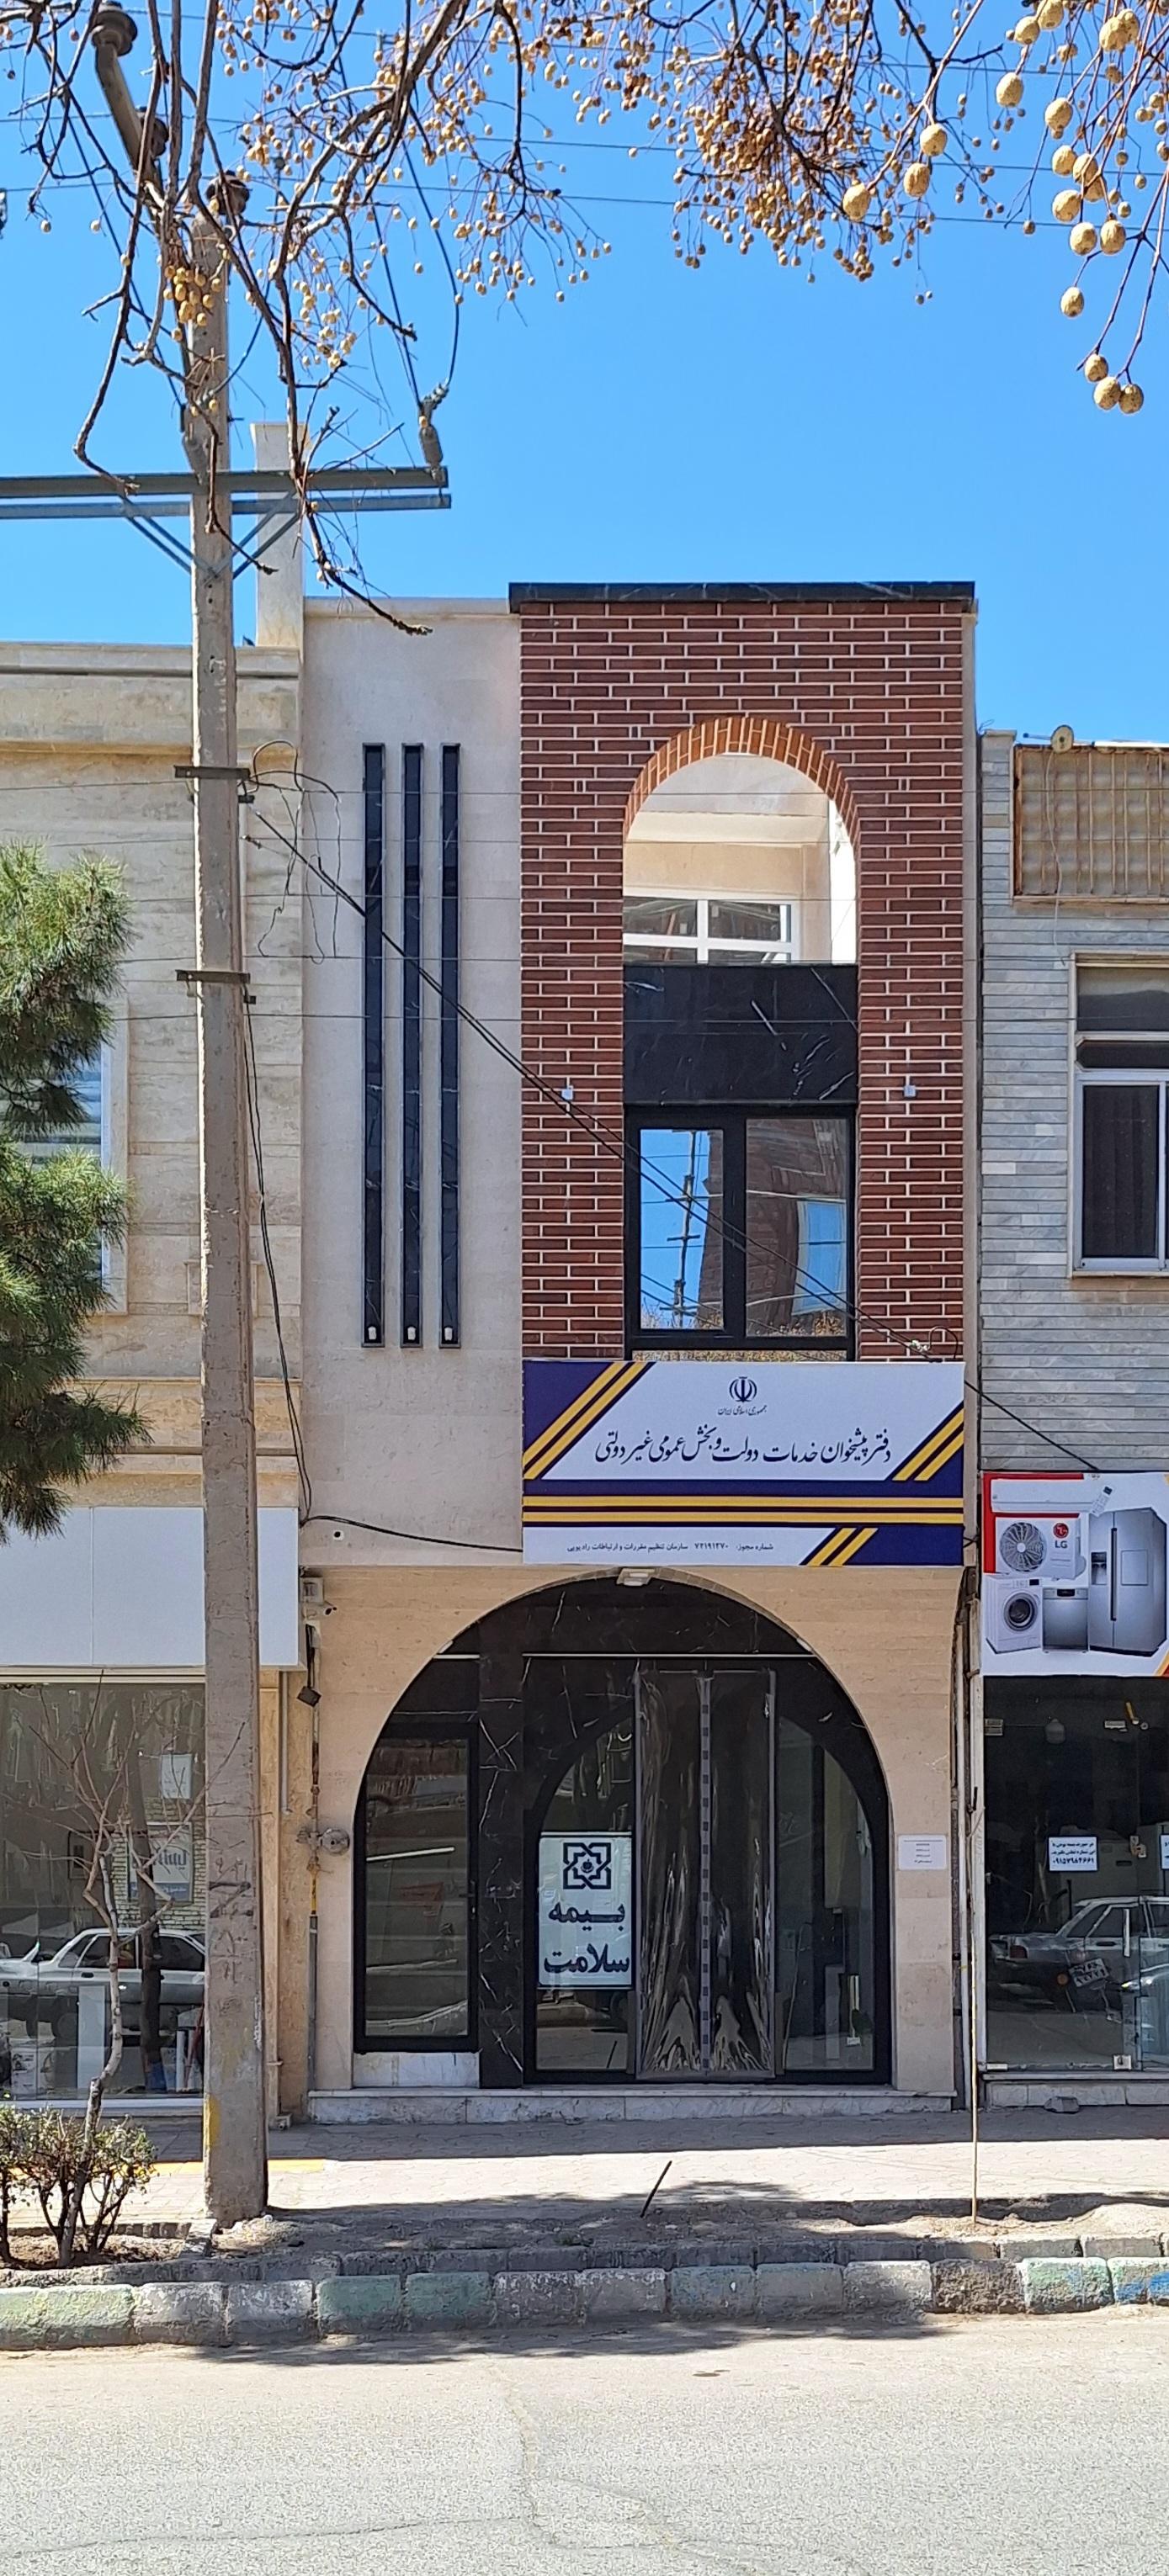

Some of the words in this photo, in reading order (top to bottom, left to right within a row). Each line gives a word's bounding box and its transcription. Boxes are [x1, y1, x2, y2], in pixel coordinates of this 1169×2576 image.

[594, 1430, 626, 1463] دولتی
[648, 1435, 687, 1463] عمومی
[681, 1423, 718, 1462] بخش
[712, 1435, 759, 1462] دولت
[763, 1442, 818, 1463] خدمات
[821, 1427, 868, 1464] پیشخوان
[860, 1428, 891, 1466] دفتر
[591, 1542, 619, 1552] ارتباطات
[624, 1542, 647, 1553] مقررات
[647, 1542, 665, 1554] تنظیم
[666, 1542, 688, 1552] سازمان
[755, 1541, 774, 1551] شماره
[1055, 1540, 1068, 1550] LG
[548, 1901, 626, 1932] بیمه
[543, 1943, 630, 1974] سلامت
